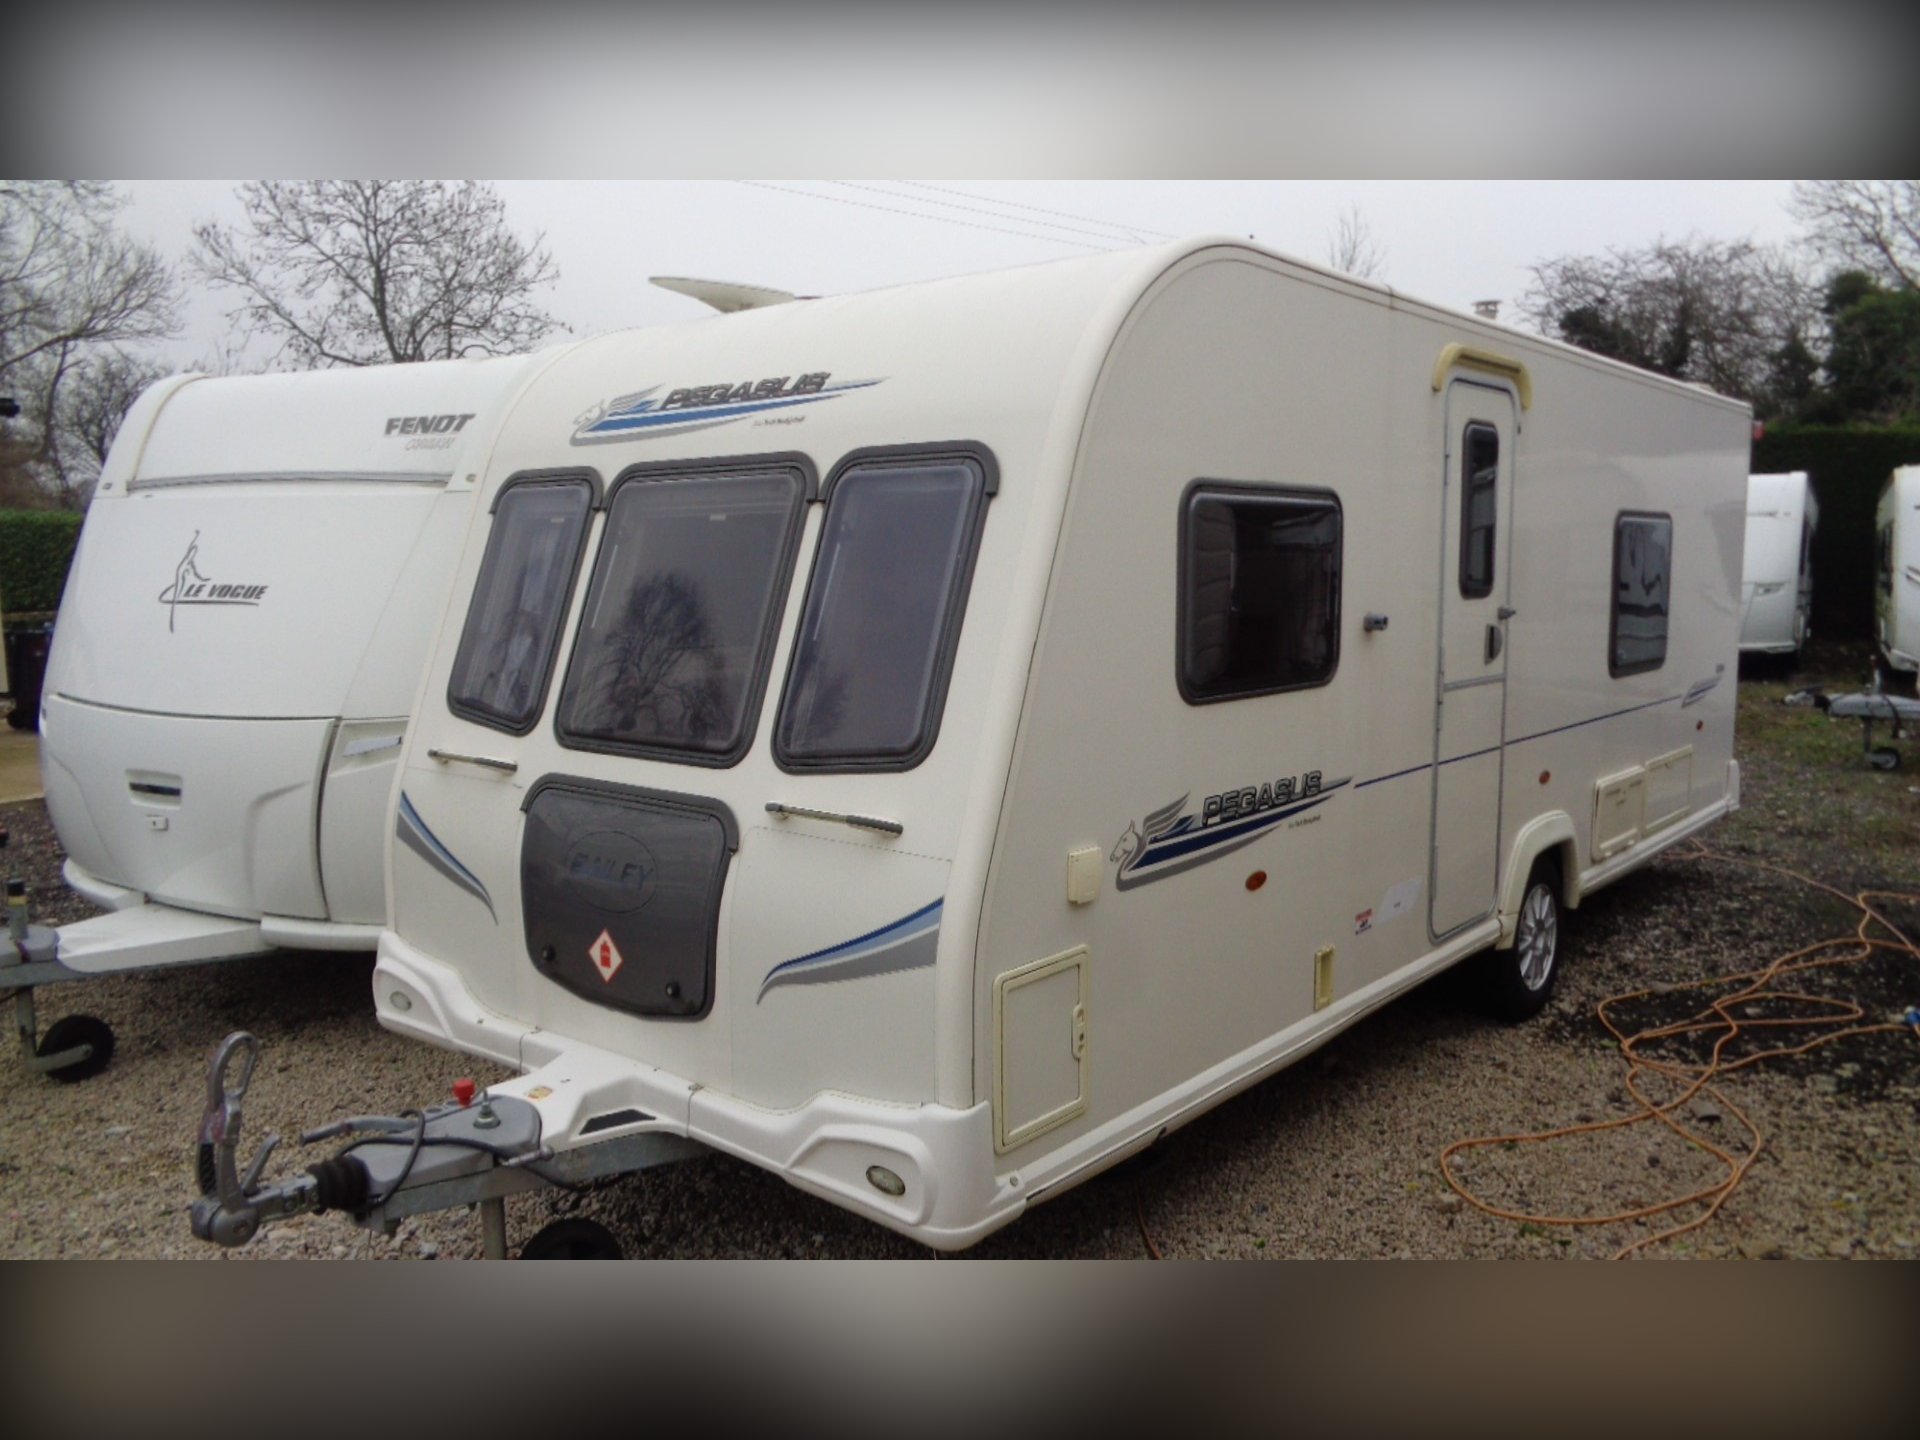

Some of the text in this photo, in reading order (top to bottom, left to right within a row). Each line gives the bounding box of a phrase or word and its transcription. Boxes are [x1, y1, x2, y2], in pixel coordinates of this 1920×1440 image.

[659, 371, 831, 410] PEGASUS
[384, 413, 476, 435] FENDT
[183, 583, 268, 600] LE VOGUE
[1202, 770, 1322, 827] PEGASUS
